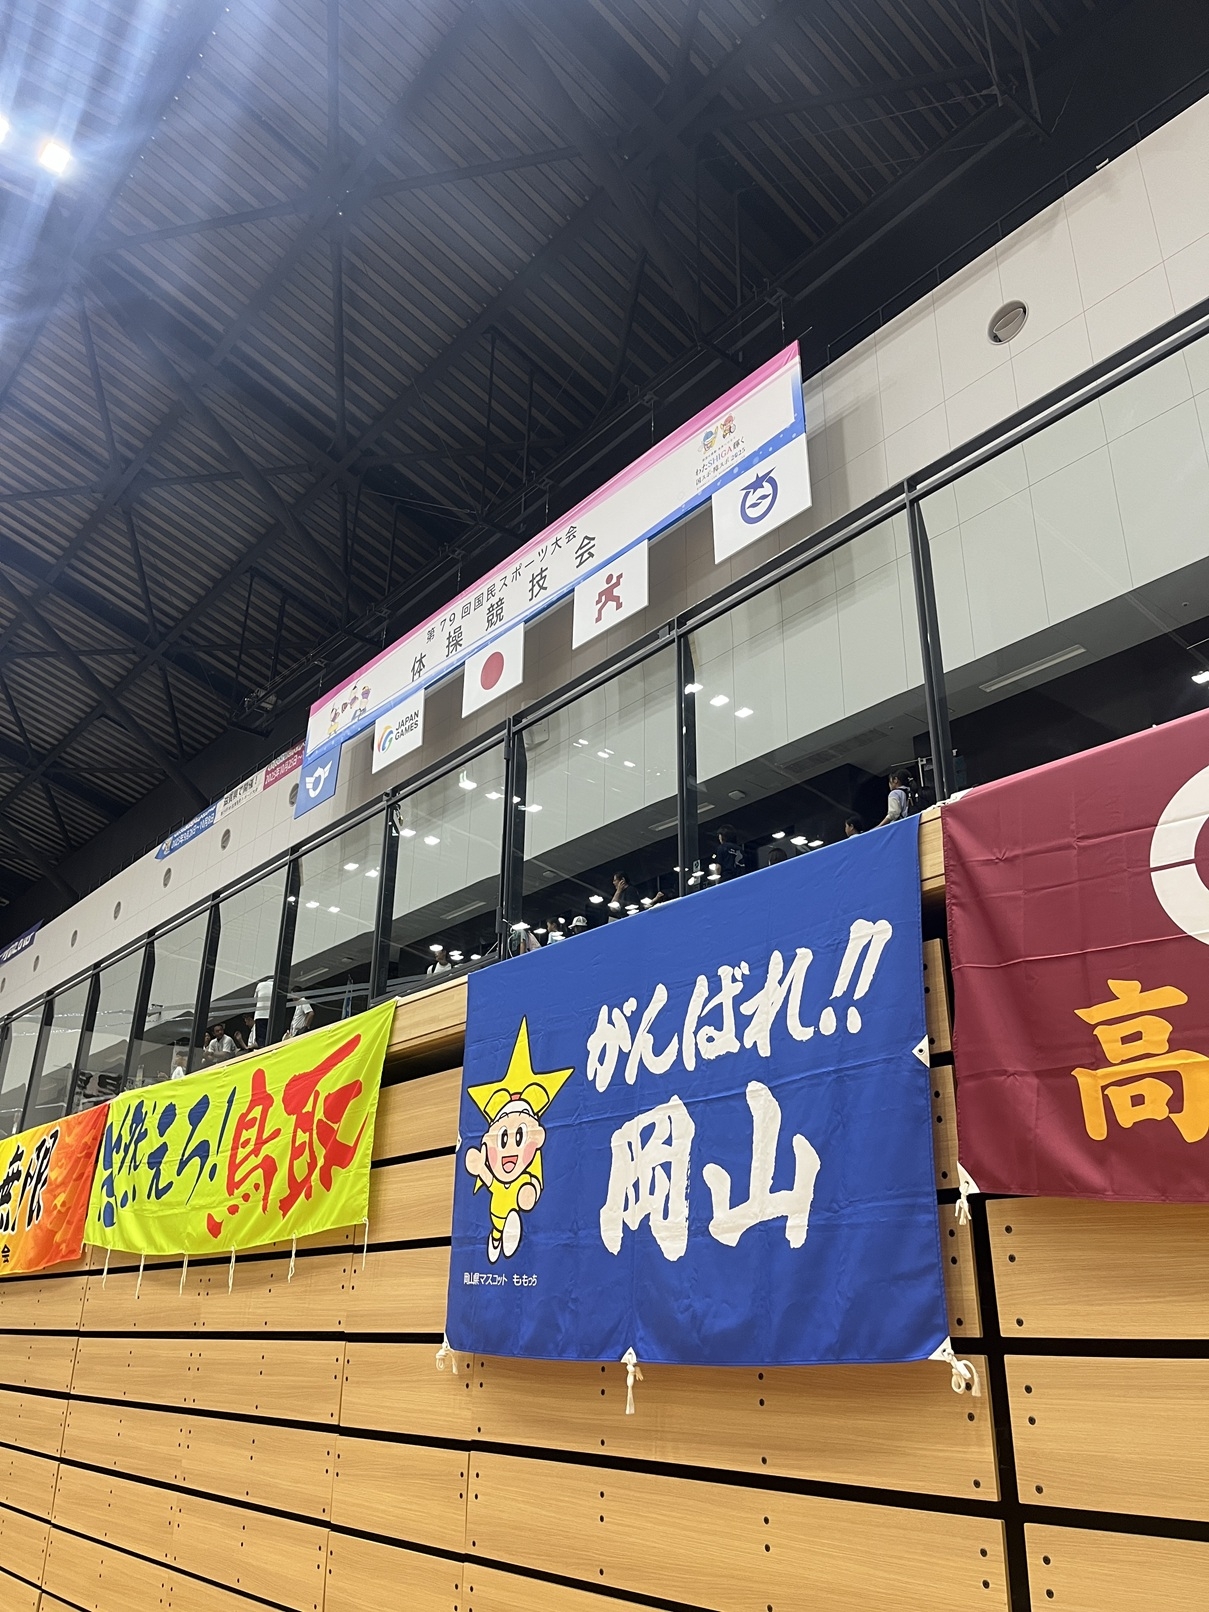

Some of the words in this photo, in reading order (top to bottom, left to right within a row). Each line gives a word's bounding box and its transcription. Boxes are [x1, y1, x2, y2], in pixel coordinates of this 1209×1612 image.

[410, 534, 597, 683] 体操競技会
[425, 525, 578, 644] 第79回国民スポーツ大会
[394, 719, 419, 741] GAMES
[395, 709, 420, 732] JAPAN
[586, 918, 893, 1092] がんばれ!!
[1070, 978, 1209, 1144] 高
[600, 1080, 822, 1262] 岡山
[463, 1272, 508, 1286] 岡山県マスコット
[512, 1273, 538, 1287] ももっち
